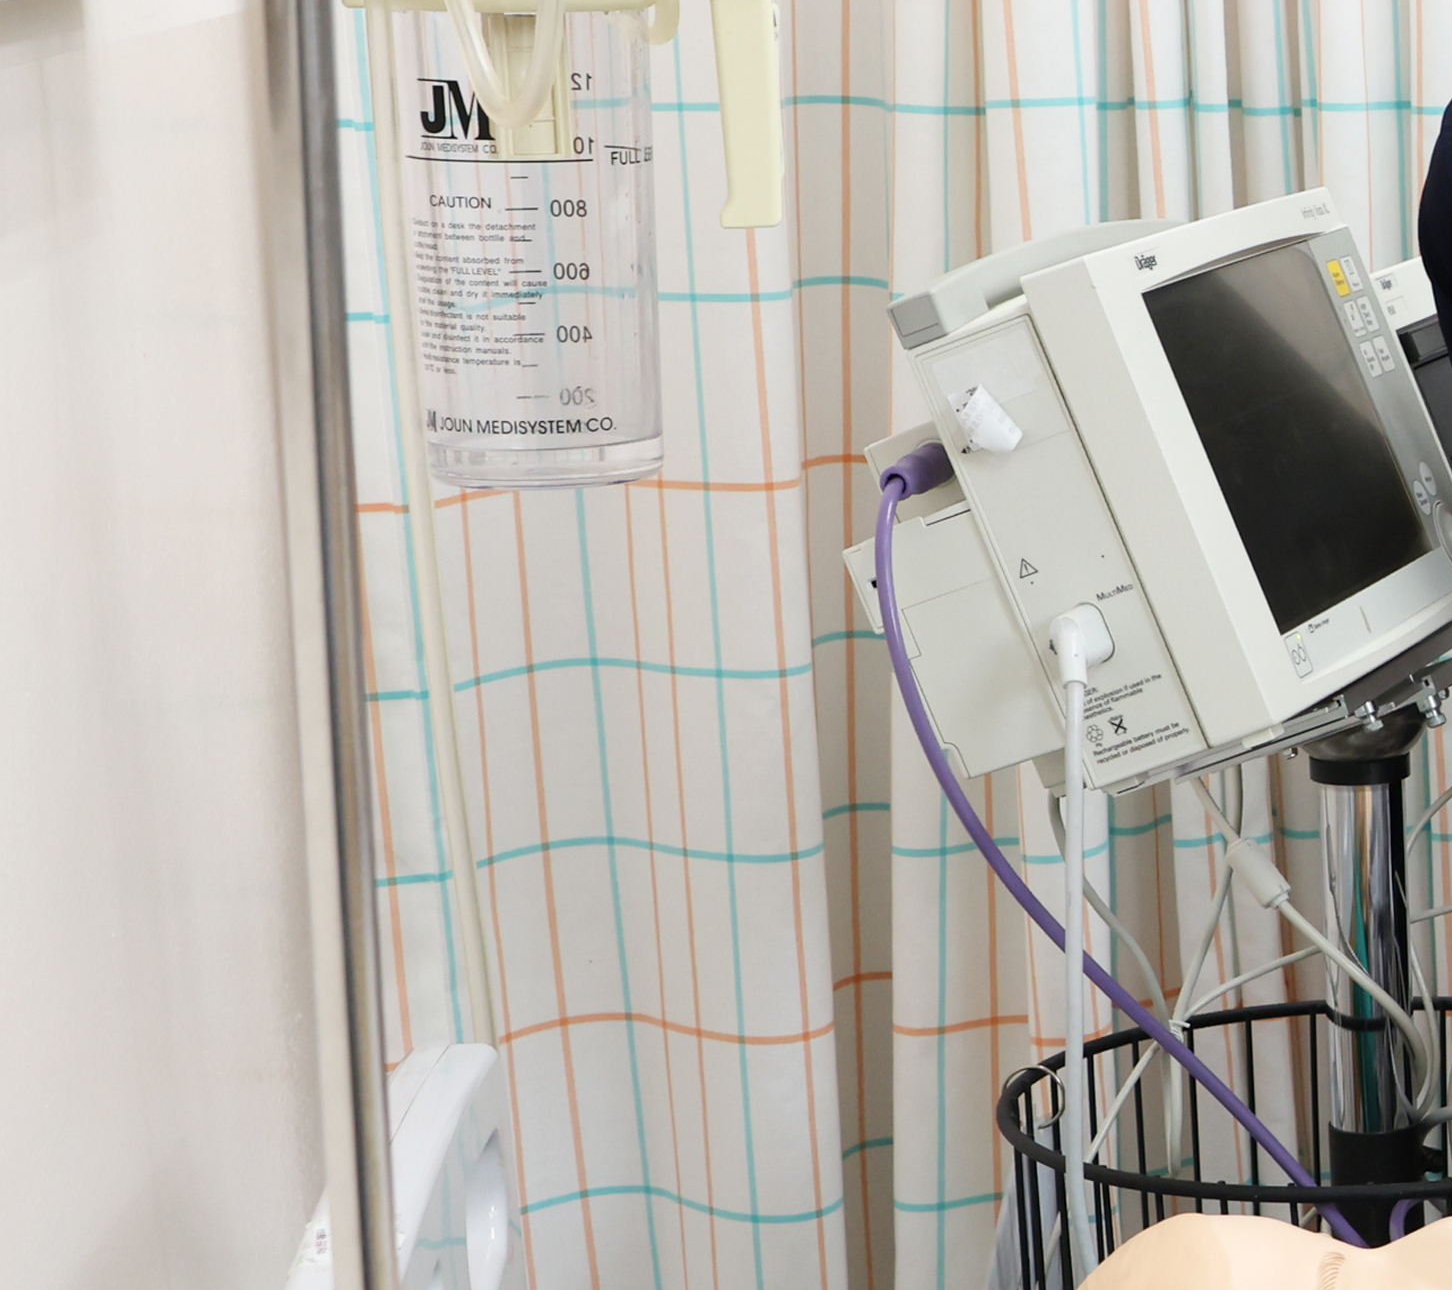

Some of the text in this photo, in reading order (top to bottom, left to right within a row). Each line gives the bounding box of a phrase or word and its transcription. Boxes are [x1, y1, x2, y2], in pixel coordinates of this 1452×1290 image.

[429, 195, 492, 210] CAUTION
[468, 222, 481, 230] the
[485, 222, 536, 231] detachment
[462, 256, 500, 265] absorbed
[503, 257, 524, 265] from
[469, 279, 499, 287] content
[521, 280, 548, 288] cause
[466, 289, 479, 299] dry
[491, 290, 544, 300] immediately
[476, 313, 489, 321] not
[492, 313, 526, 321] suitable
[494, 335, 544, 344] accordance
[462, 354, 510, 367] temperature
[439, 416, 473, 434] JOUN
[476, 418, 582, 435] MEDISYSTEM
[585, 416, 618, 433] CO.
[1093, 686, 1123, 706] explosion
[1092, 736, 1133, 758] Rechargeable
[1133, 729, 1154, 745] battery
[1155, 725, 1171, 736] must
[1097, 751, 1122, 764] recycled
[1129, 738, 1156, 754] disposed
[1164, 727, 1190, 743] properly.
